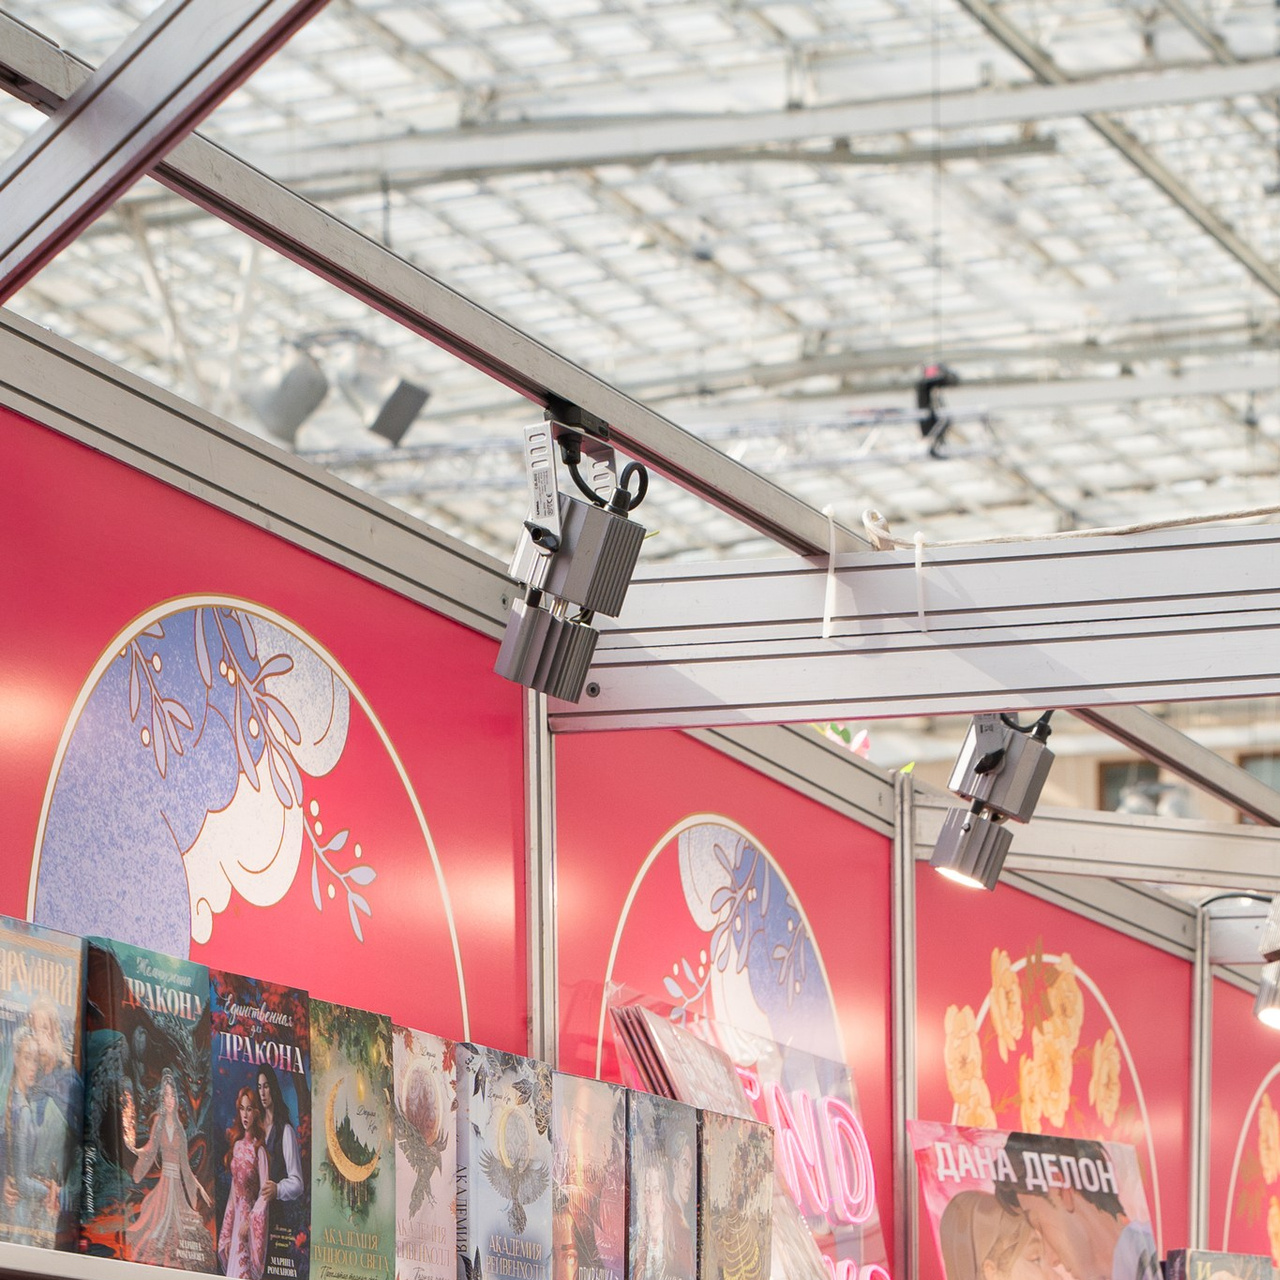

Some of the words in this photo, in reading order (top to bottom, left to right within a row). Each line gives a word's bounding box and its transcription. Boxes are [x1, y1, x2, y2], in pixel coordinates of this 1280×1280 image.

[121, 976, 202, 1022] ДРАКОНА
[223, 993, 295, 1028] Единственная
[218, 1031, 305, 1075] ДРАКОНА
[934, 1141, 1017, 1183] ДАНА
[1022, 1150, 1119, 1195] ДЕЛОН
[455, 1163, 468, 1253] АКАДЕМИЯ
[324, 1227, 379, 1251] АКАДЕМИЯ
[488, 1234, 542, 1260] АКАДЕМИЯ
[267, 1266, 298, 1278] РОМАНОВА
[271, 1257, 295, 1267] МАРИНА
[360, 1252, 389, 1272] СВЕТА
